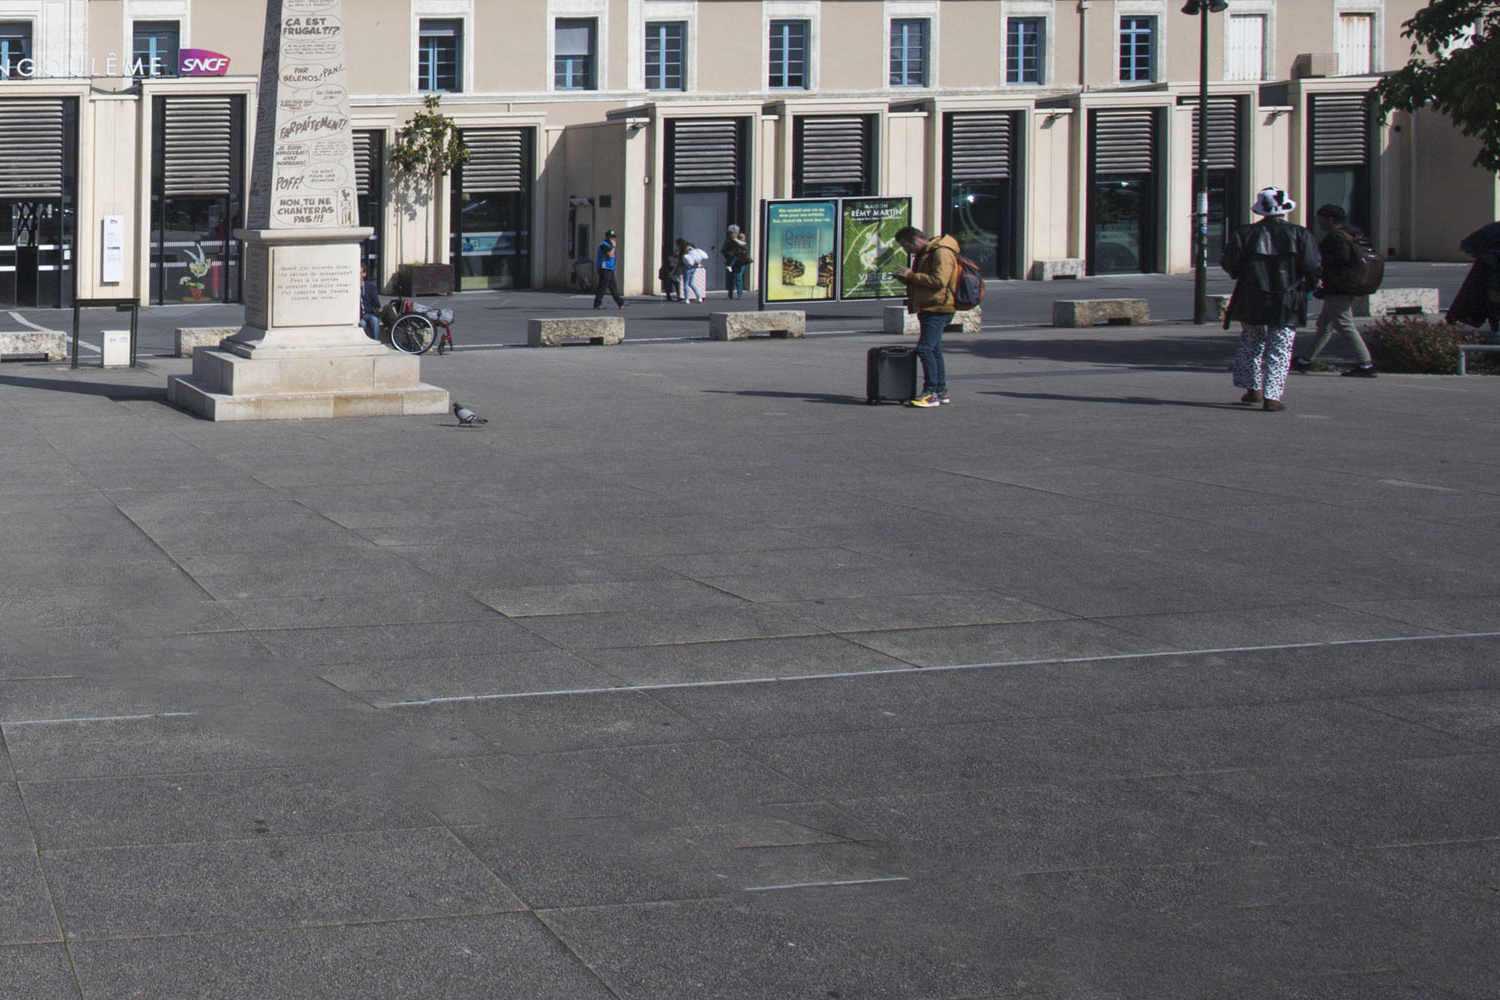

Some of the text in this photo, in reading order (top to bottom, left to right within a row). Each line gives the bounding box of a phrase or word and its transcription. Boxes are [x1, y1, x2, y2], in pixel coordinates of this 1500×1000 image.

[306, 18, 326, 26] EST
[181, 58, 229, 72] SNCF
[276, 176, 304, 191] POFF!
[303, 198, 315, 206] TU
[318, 197, 331, 205] NE
[277, 206, 334, 215] CHANTERAS
[851, 208, 902, 216] RÉMY MARTIN
[858, 272, 893, 280] VISITES
